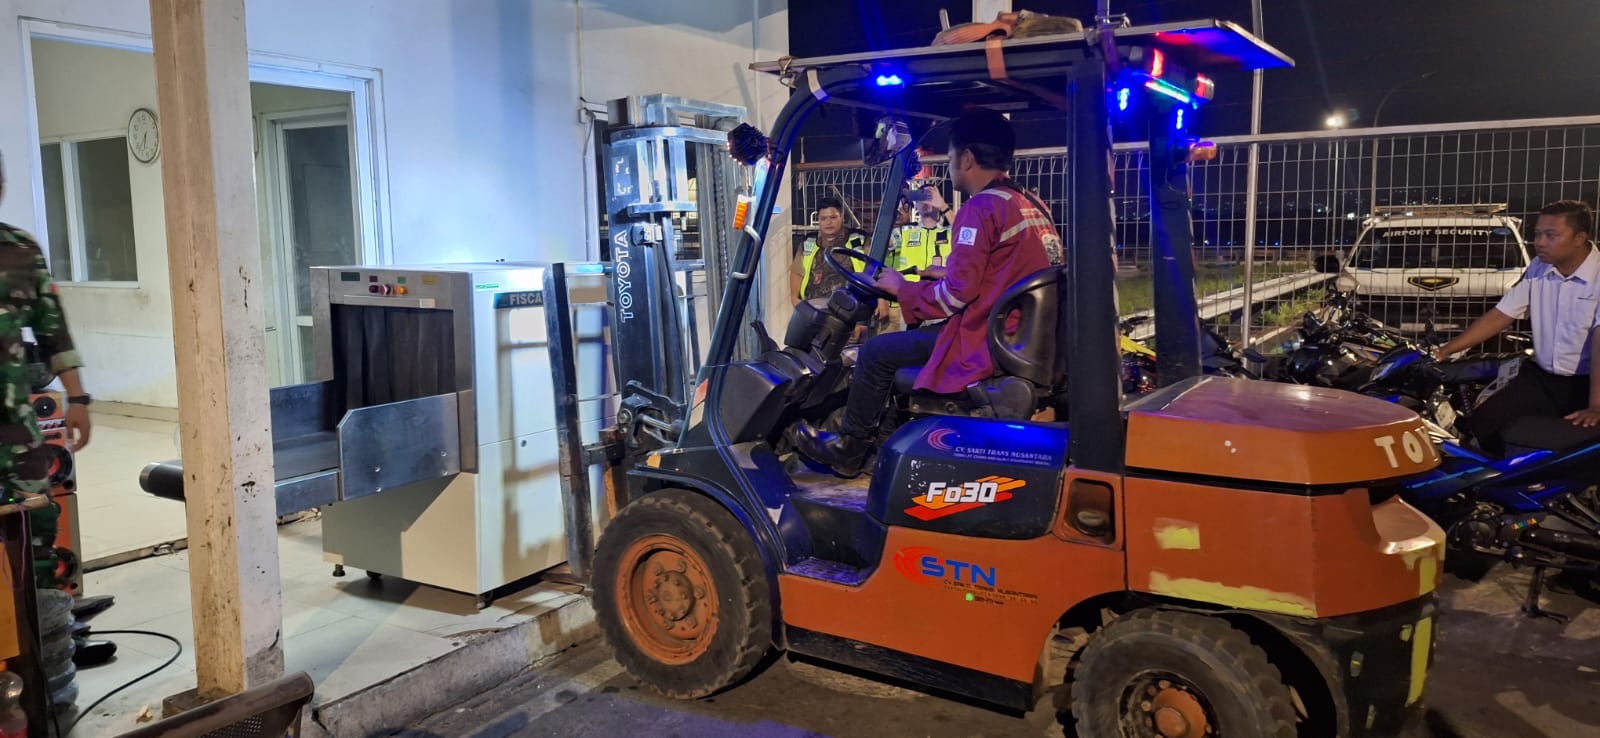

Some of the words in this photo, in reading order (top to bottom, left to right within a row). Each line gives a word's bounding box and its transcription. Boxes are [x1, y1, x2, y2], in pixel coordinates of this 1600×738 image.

[1382, 229, 1432, 238] AIRPORT
[1434, 229, 1493, 237] SECURITY
[614, 229, 634, 323] TOYOTA
[921, 556, 996, 587] STN
